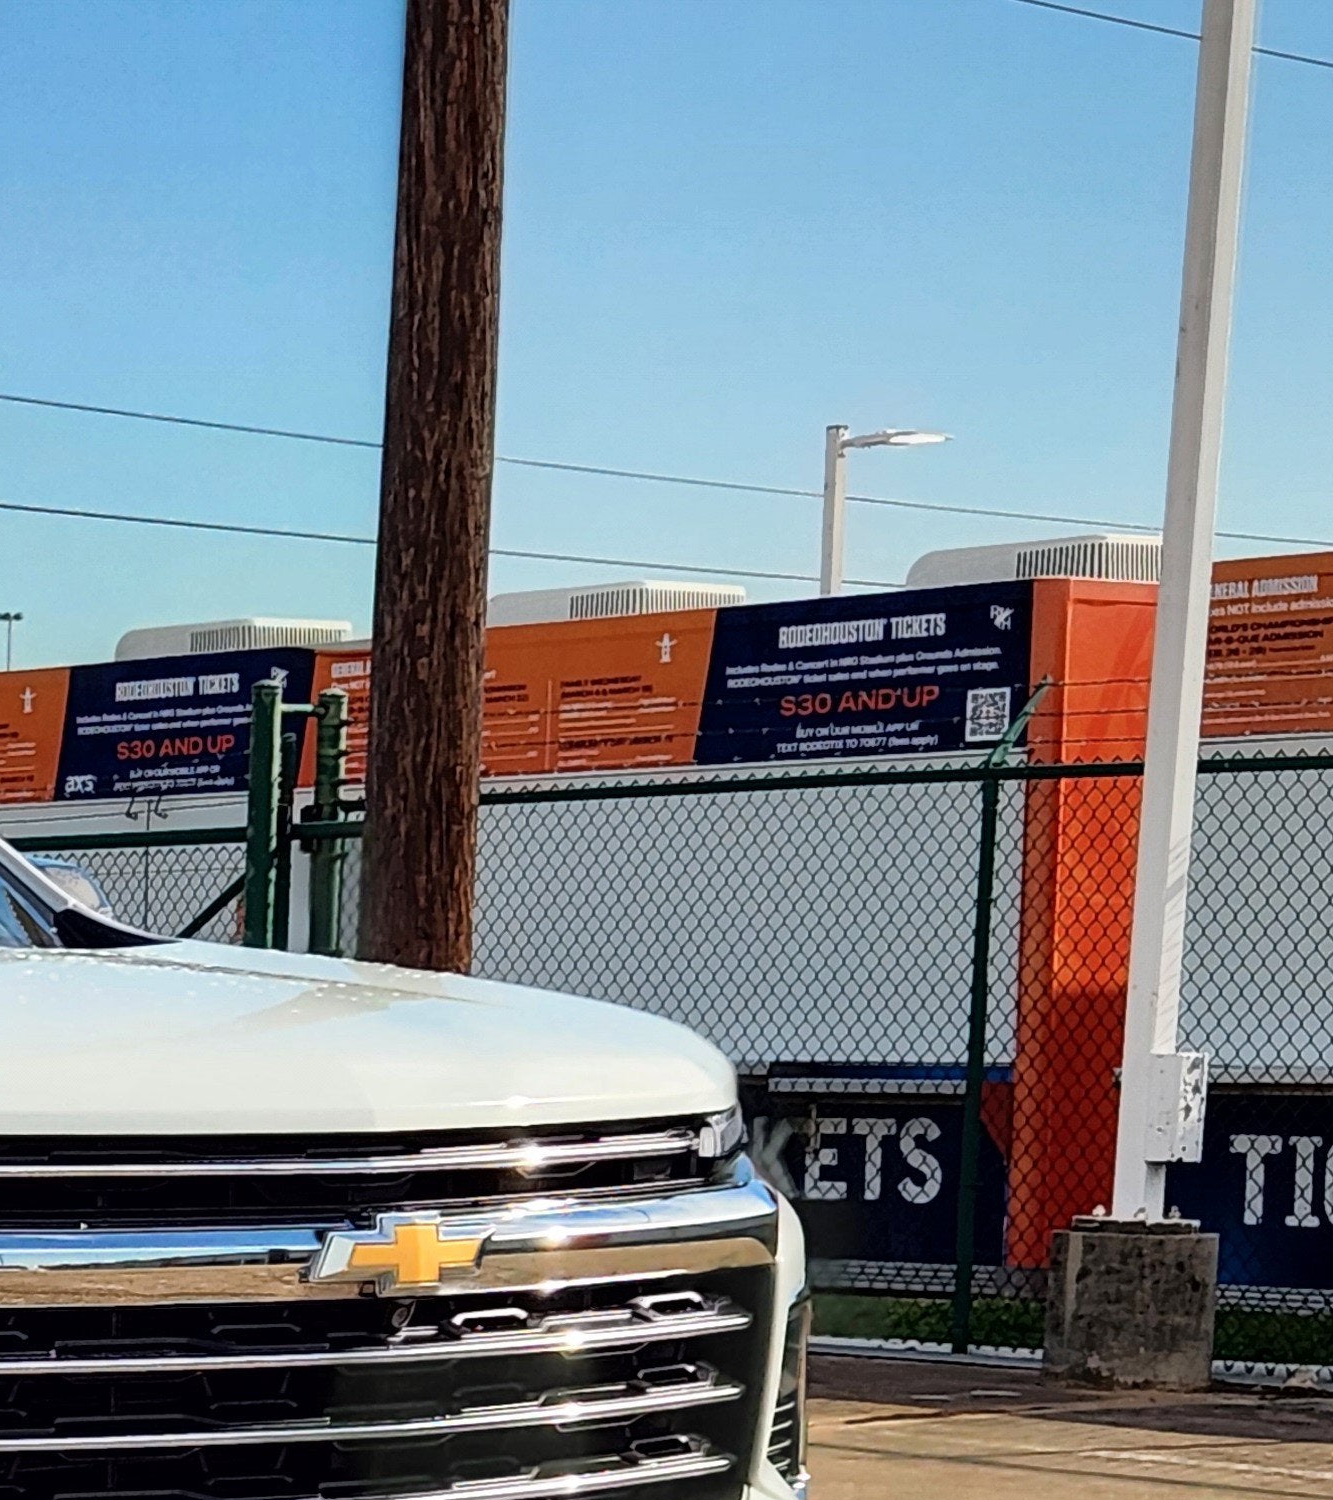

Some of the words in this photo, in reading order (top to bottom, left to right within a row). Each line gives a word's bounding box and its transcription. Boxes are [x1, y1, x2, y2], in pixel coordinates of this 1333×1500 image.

[890, 612, 947, 640] TICKETS
[837, 688, 896, 713] AND
[902, 685, 941, 709] UP
[159, 735, 203, 758] AND
[206, 734, 235, 754] UP
[1229, 1133, 1333, 1228] TI
